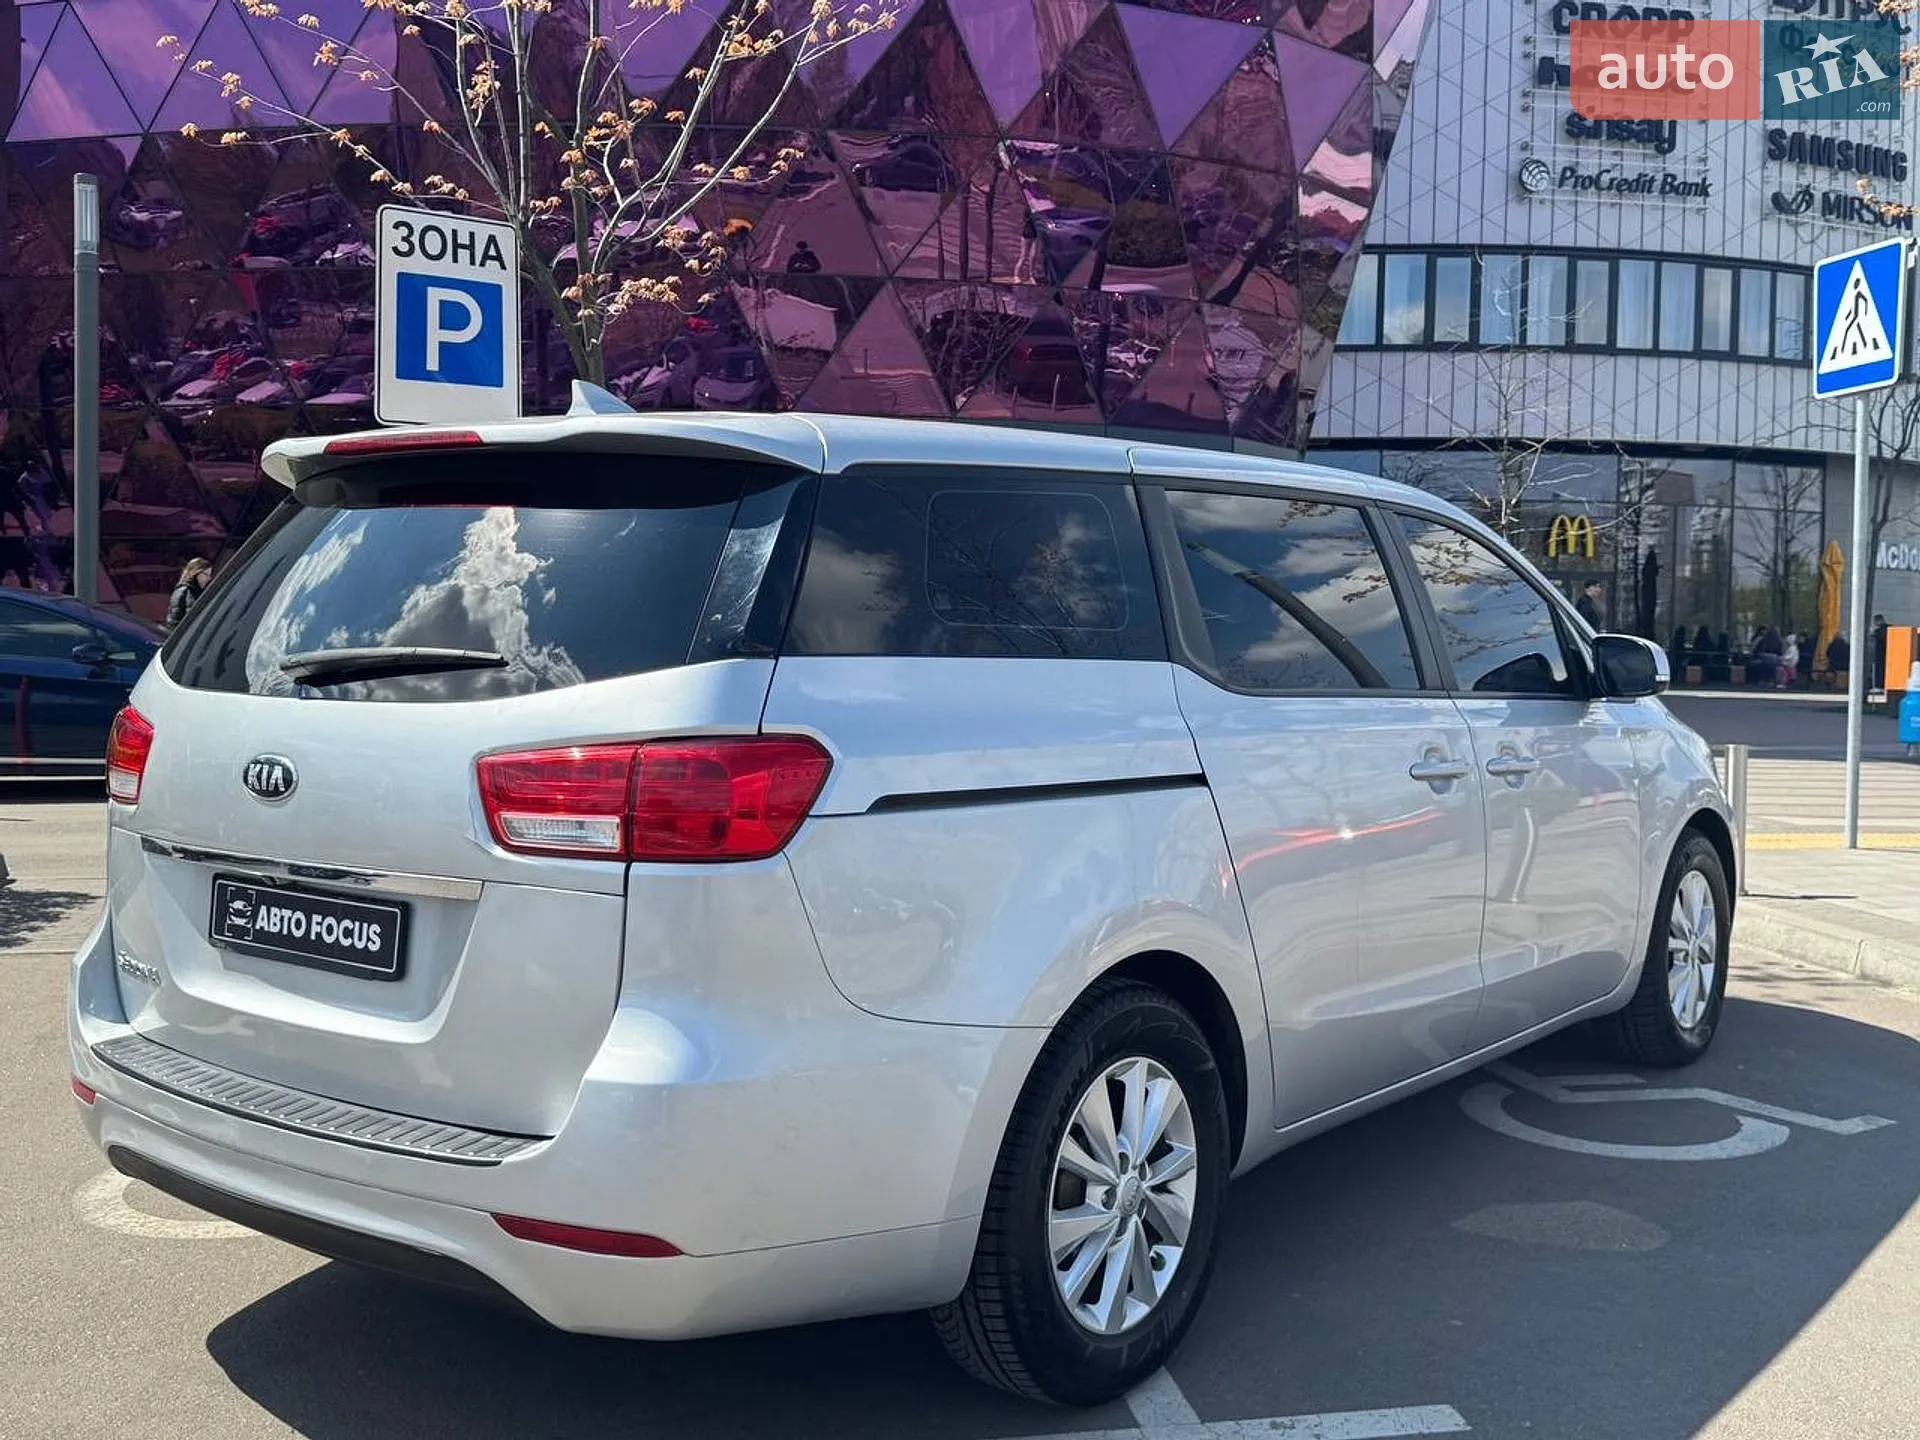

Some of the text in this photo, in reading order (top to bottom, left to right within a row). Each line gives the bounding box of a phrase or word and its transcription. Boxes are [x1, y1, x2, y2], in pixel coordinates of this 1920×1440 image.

[1552, 1, 1694, 42] CROPP
[1768, 128, 1907, 182] SAMSUNG
[1558, 166, 1713, 198] ProCredit Bank
[392, 221, 506, 270] ЗОНА
[427, 287, 482, 371] P
[248, 763, 285, 791] KIA
[310, 914, 382, 952] FOCUS
